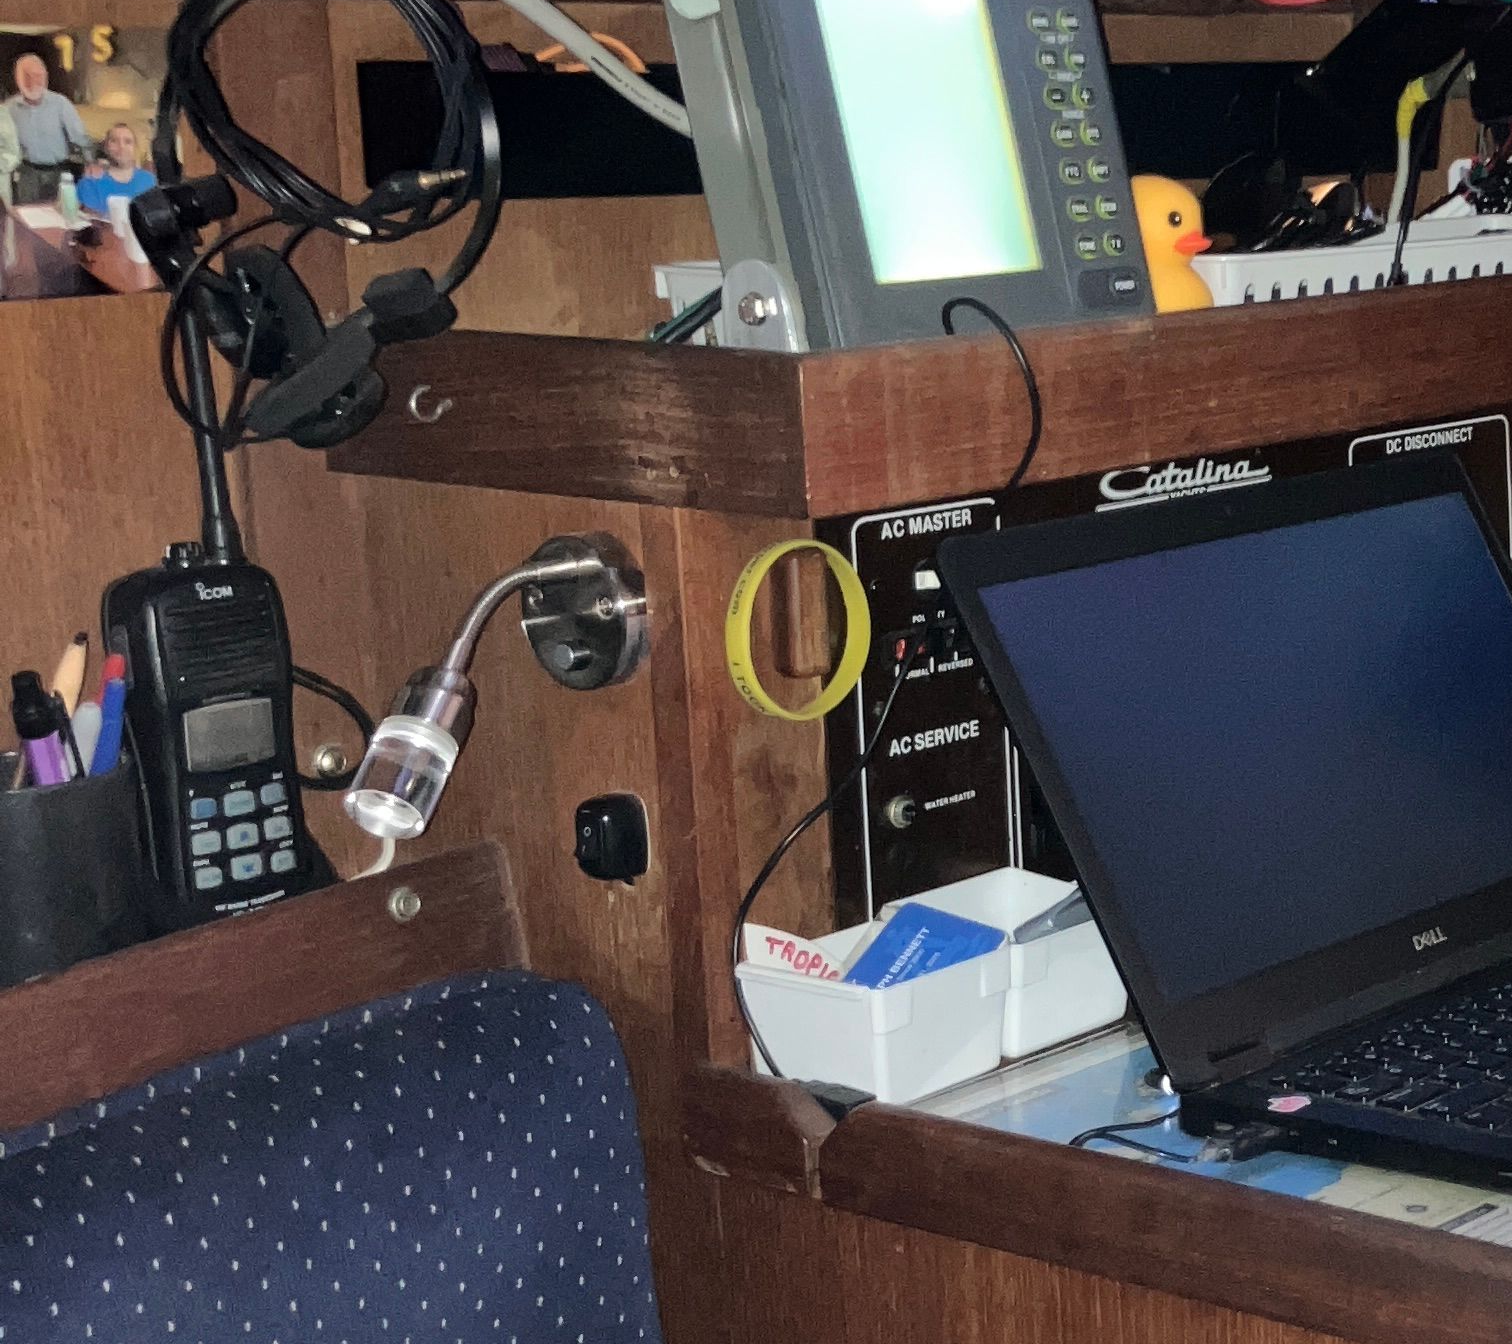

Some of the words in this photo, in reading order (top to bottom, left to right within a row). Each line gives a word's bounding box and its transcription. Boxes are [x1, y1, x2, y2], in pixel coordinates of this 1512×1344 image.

[1386, 438, 1403, 455] DC
[1404, 427, 1473, 451] DISCONNECT
[1099, 458, 1270, 501] Catalina
[880, 519, 905, 540] AC
[909, 508, 973, 535] MASTER
[889, 736, 912, 757] AC
[914, 719, 980, 751] SERVICE
[924, 797, 949, 810] WATER
[949, 790, 976, 804] HEATER
[1412, 926, 1448, 951] DELL
